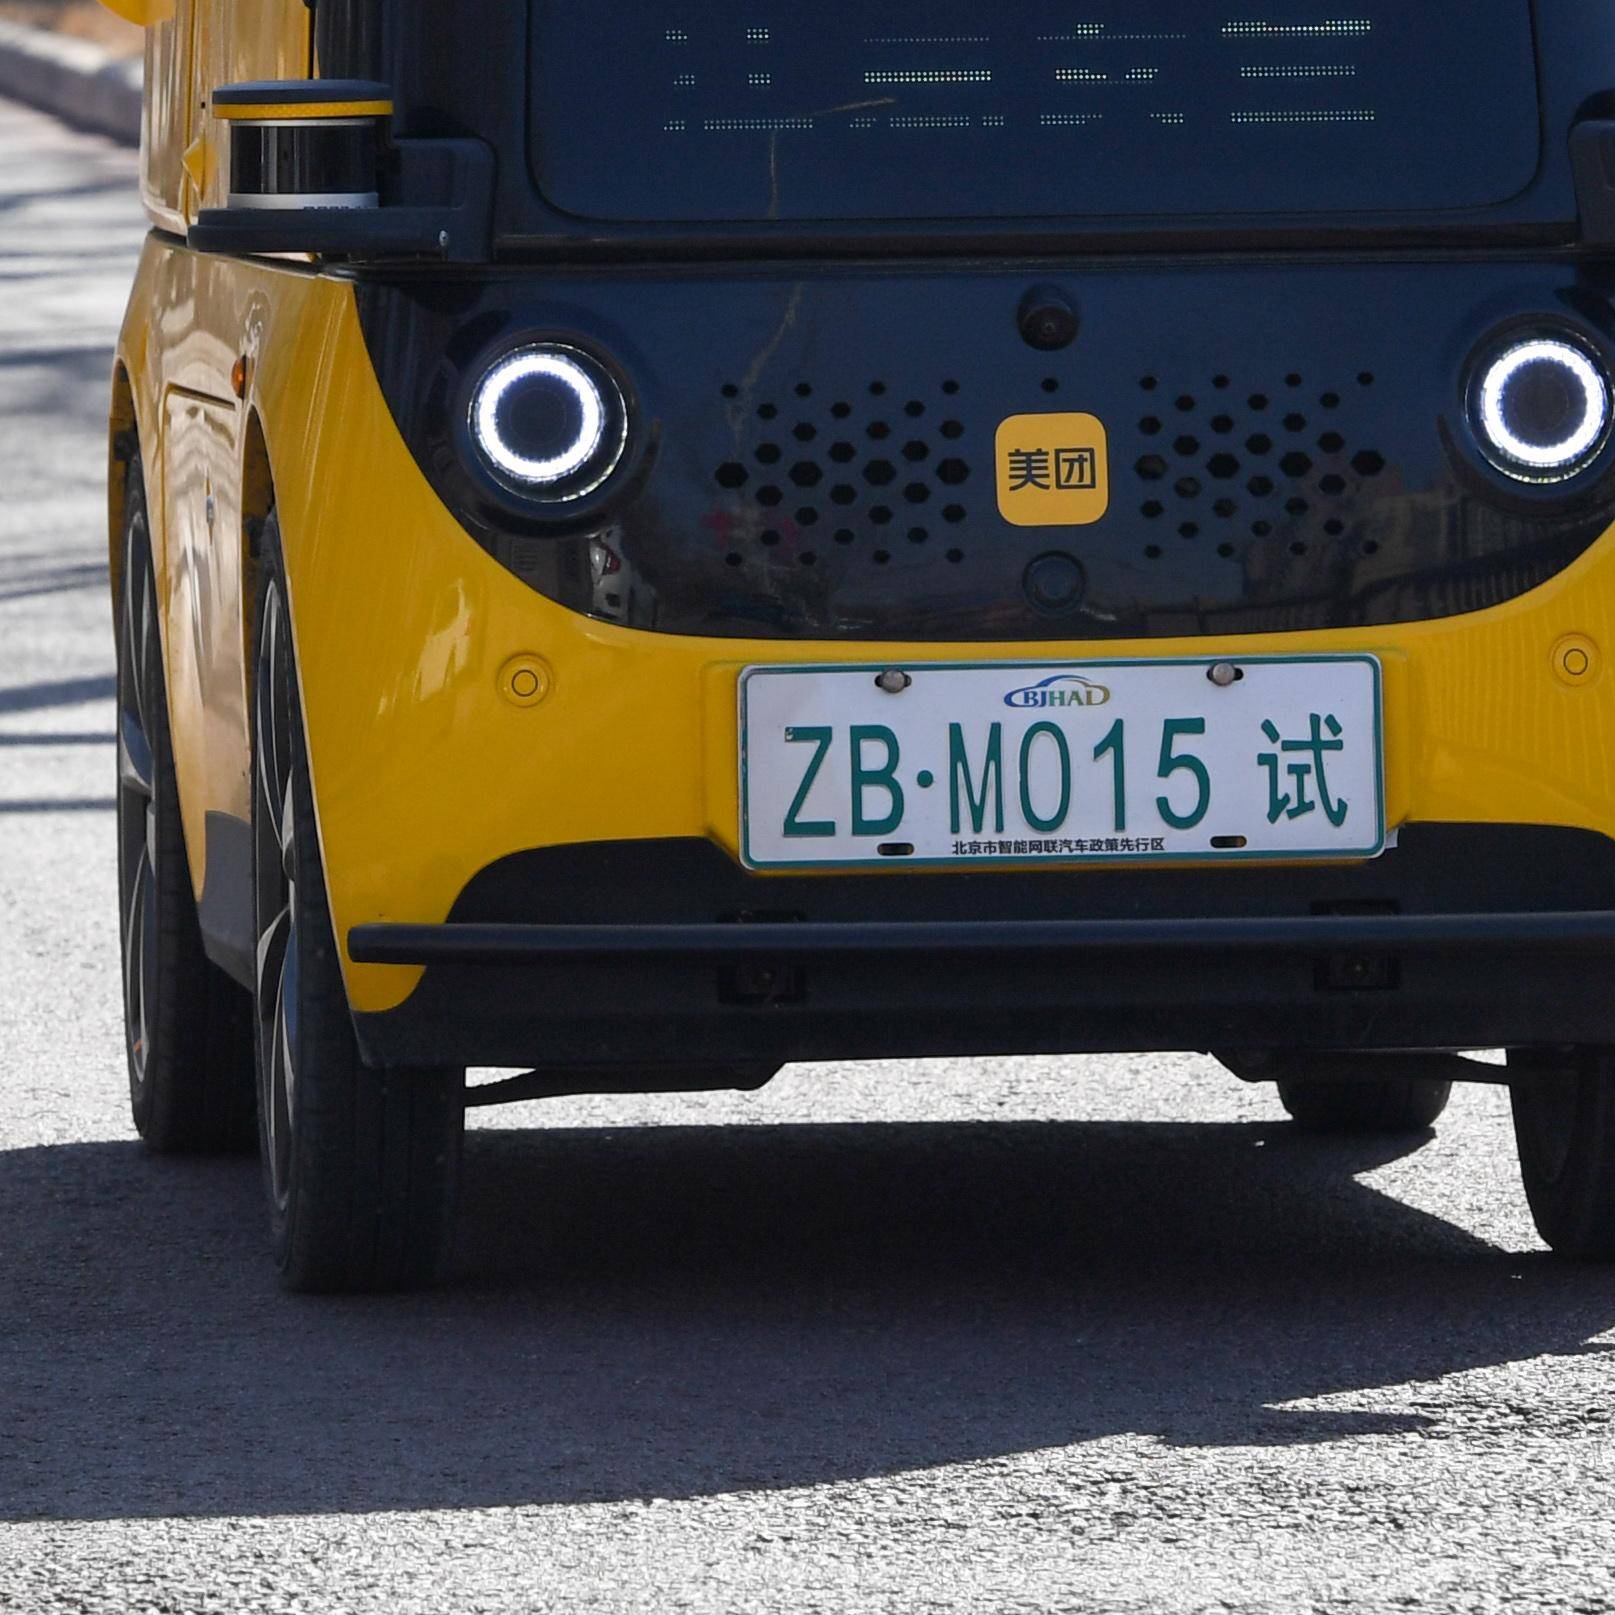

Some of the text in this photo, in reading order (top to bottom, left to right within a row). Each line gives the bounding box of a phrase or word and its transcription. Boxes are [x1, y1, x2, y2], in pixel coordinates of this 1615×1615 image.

[1008, 447, 1096, 492] 美团
[1257, 713, 1349, 827] 试
[951, 837, 1166, 855] 北京市智能网联汽车政策先行区
